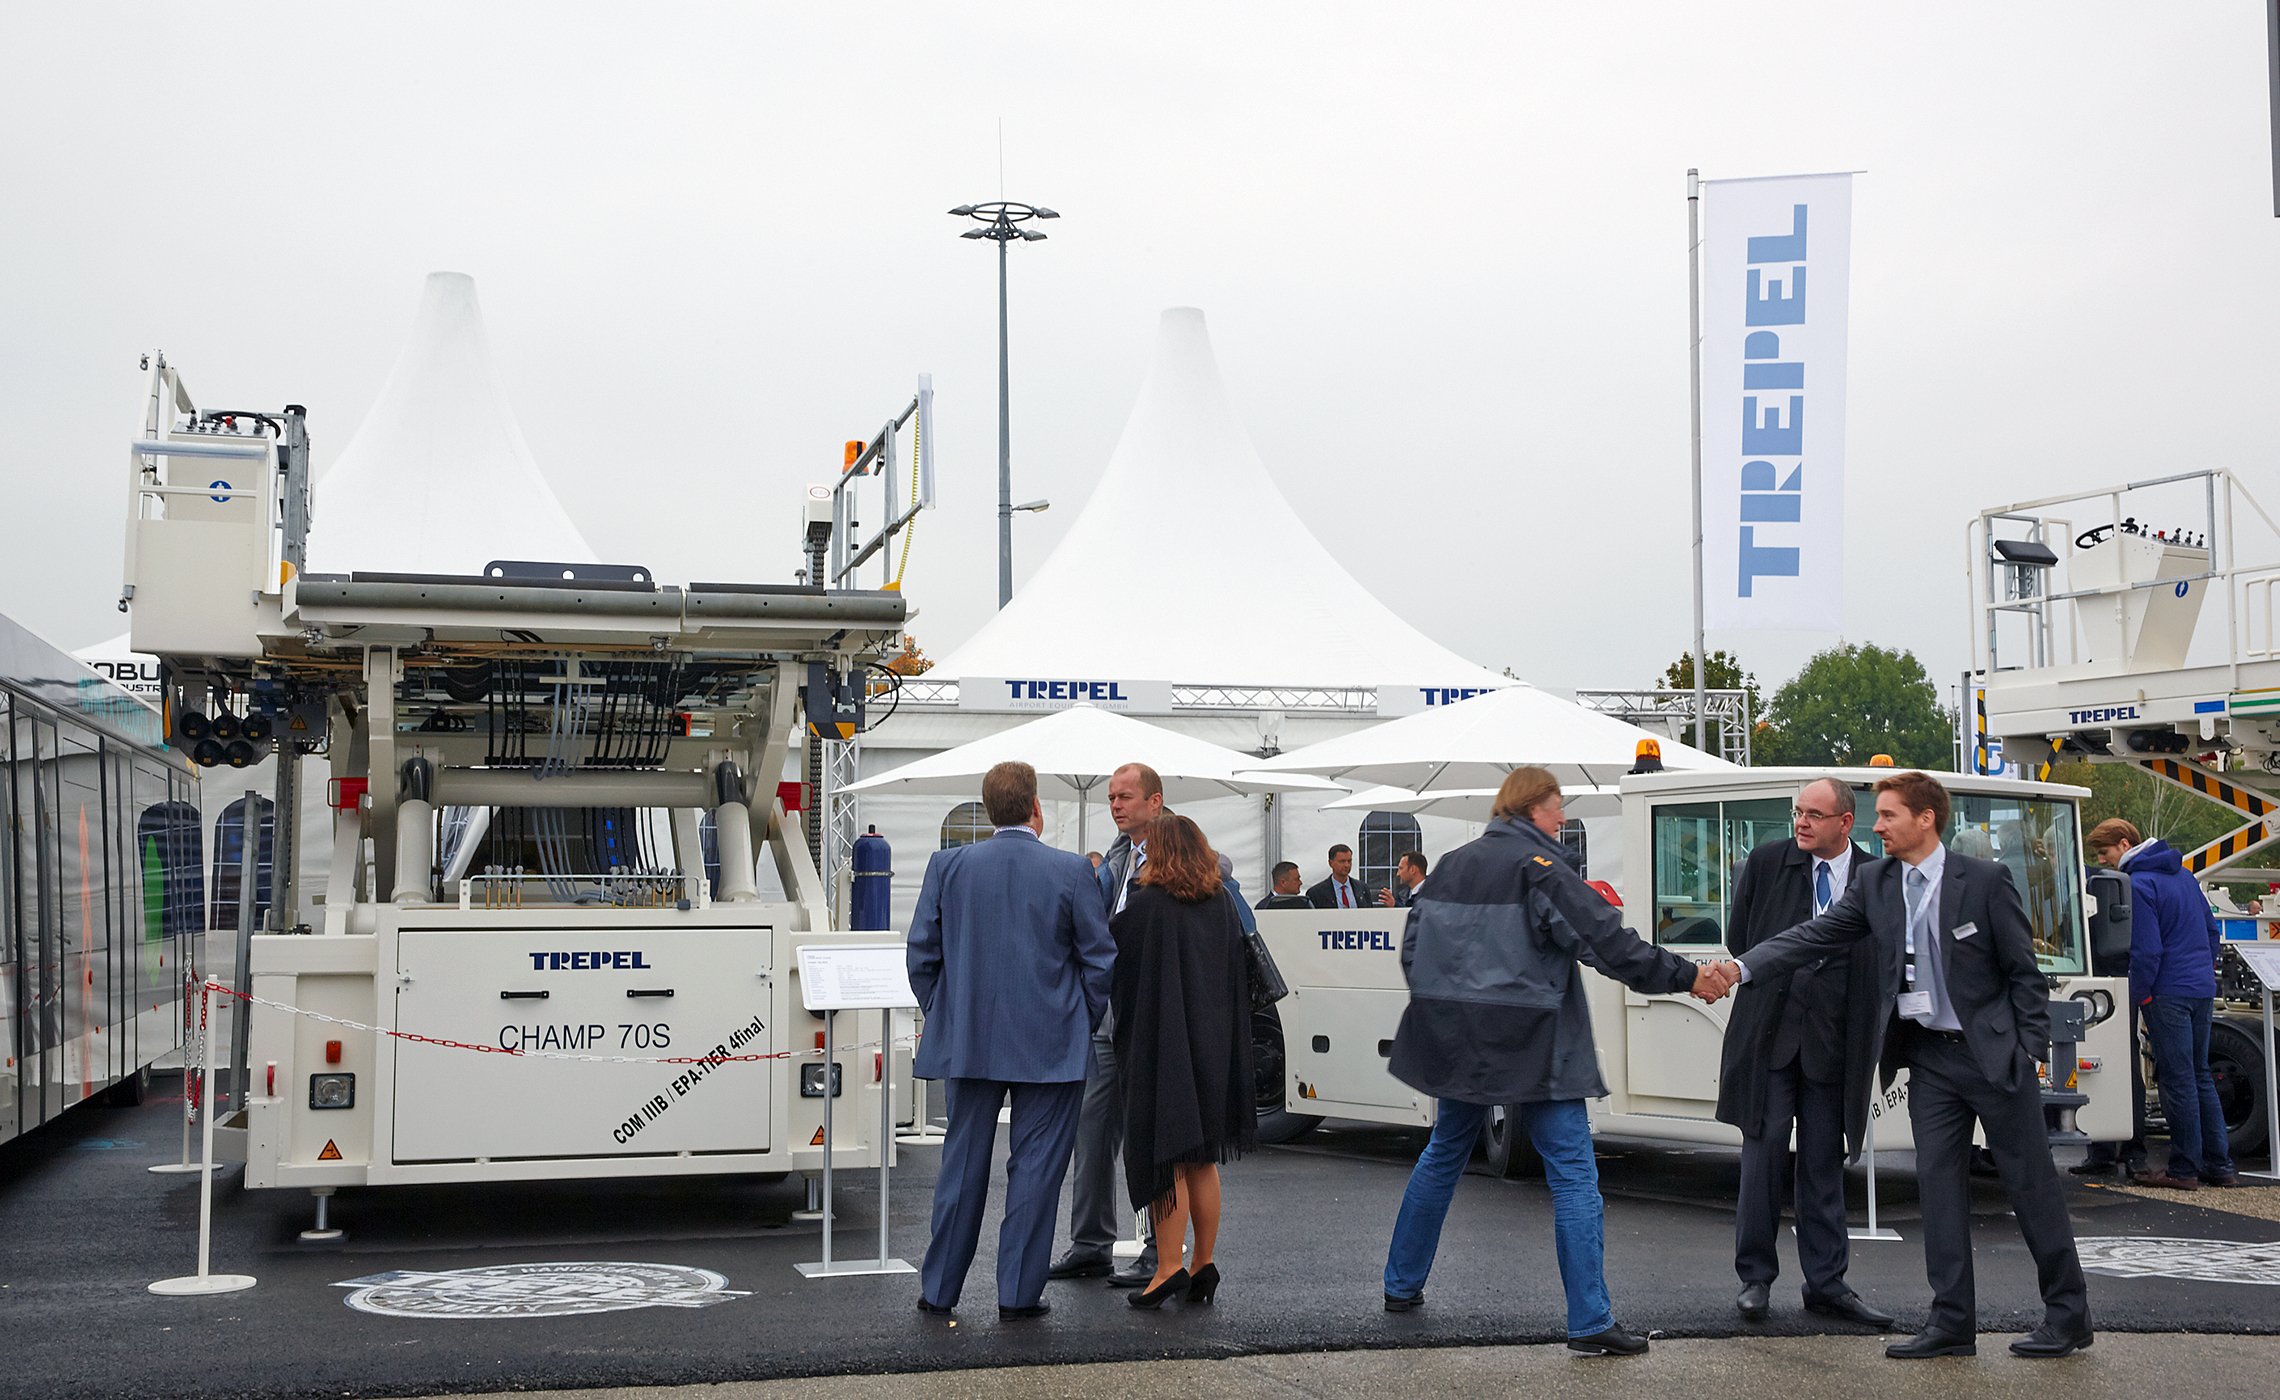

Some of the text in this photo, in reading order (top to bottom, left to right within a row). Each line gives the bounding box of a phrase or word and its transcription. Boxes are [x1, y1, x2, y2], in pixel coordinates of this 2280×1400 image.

[1738, 204, 1808, 597] TREPEL
[87, 662, 161, 681] OBU
[1005, 680, 1128, 701] TREPEL
[2068, 706, 2141, 725] TREPEL
[1317, 930, 1396, 951] TREPEL
[528, 951, 652, 971] TREPEL
[499, 1023, 672, 1051] CHAMP 70S
[612, 1015, 766, 1145] COM IIIB / EPA-TIER 4final
